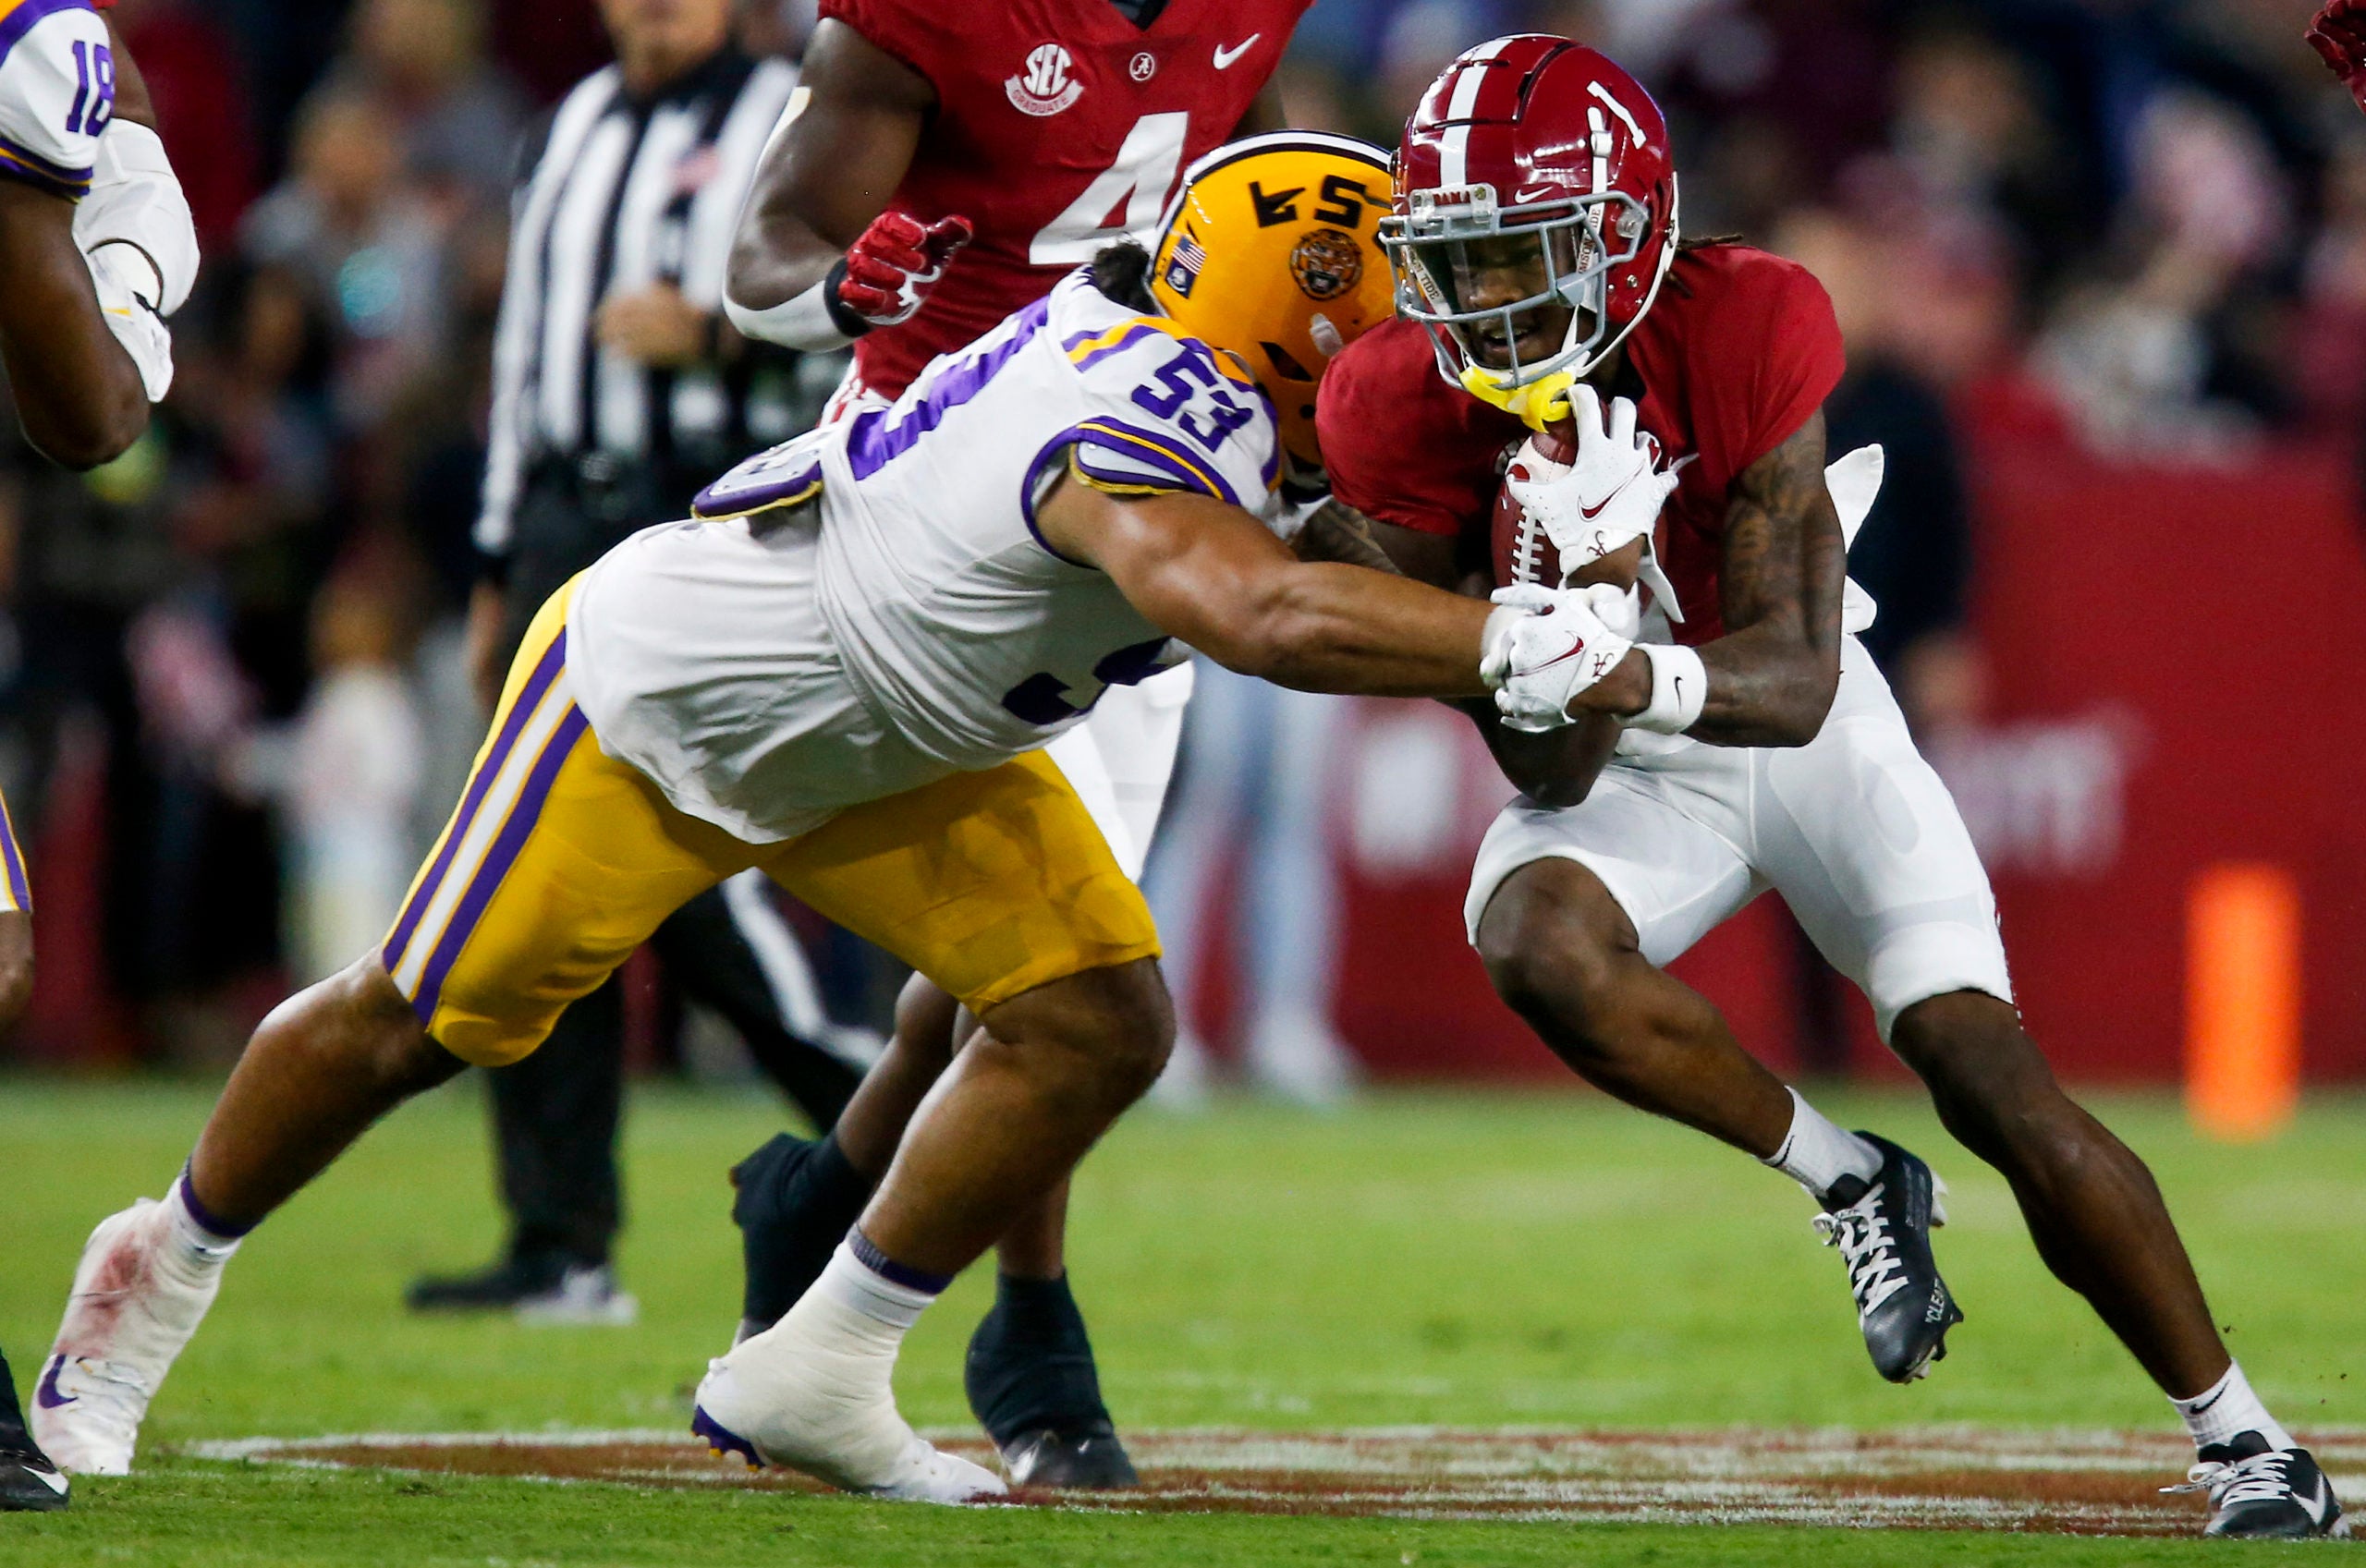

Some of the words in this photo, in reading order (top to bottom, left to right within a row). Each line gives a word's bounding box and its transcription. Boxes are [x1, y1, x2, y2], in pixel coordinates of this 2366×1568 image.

[66, 40, 116, 137] 18
[1013, 90, 1068, 114] GRADUATE
[1022, 43, 1072, 95] SEC
[1029, 112, 1189, 265] 4
[1130, 346, 1253, 454] 53
